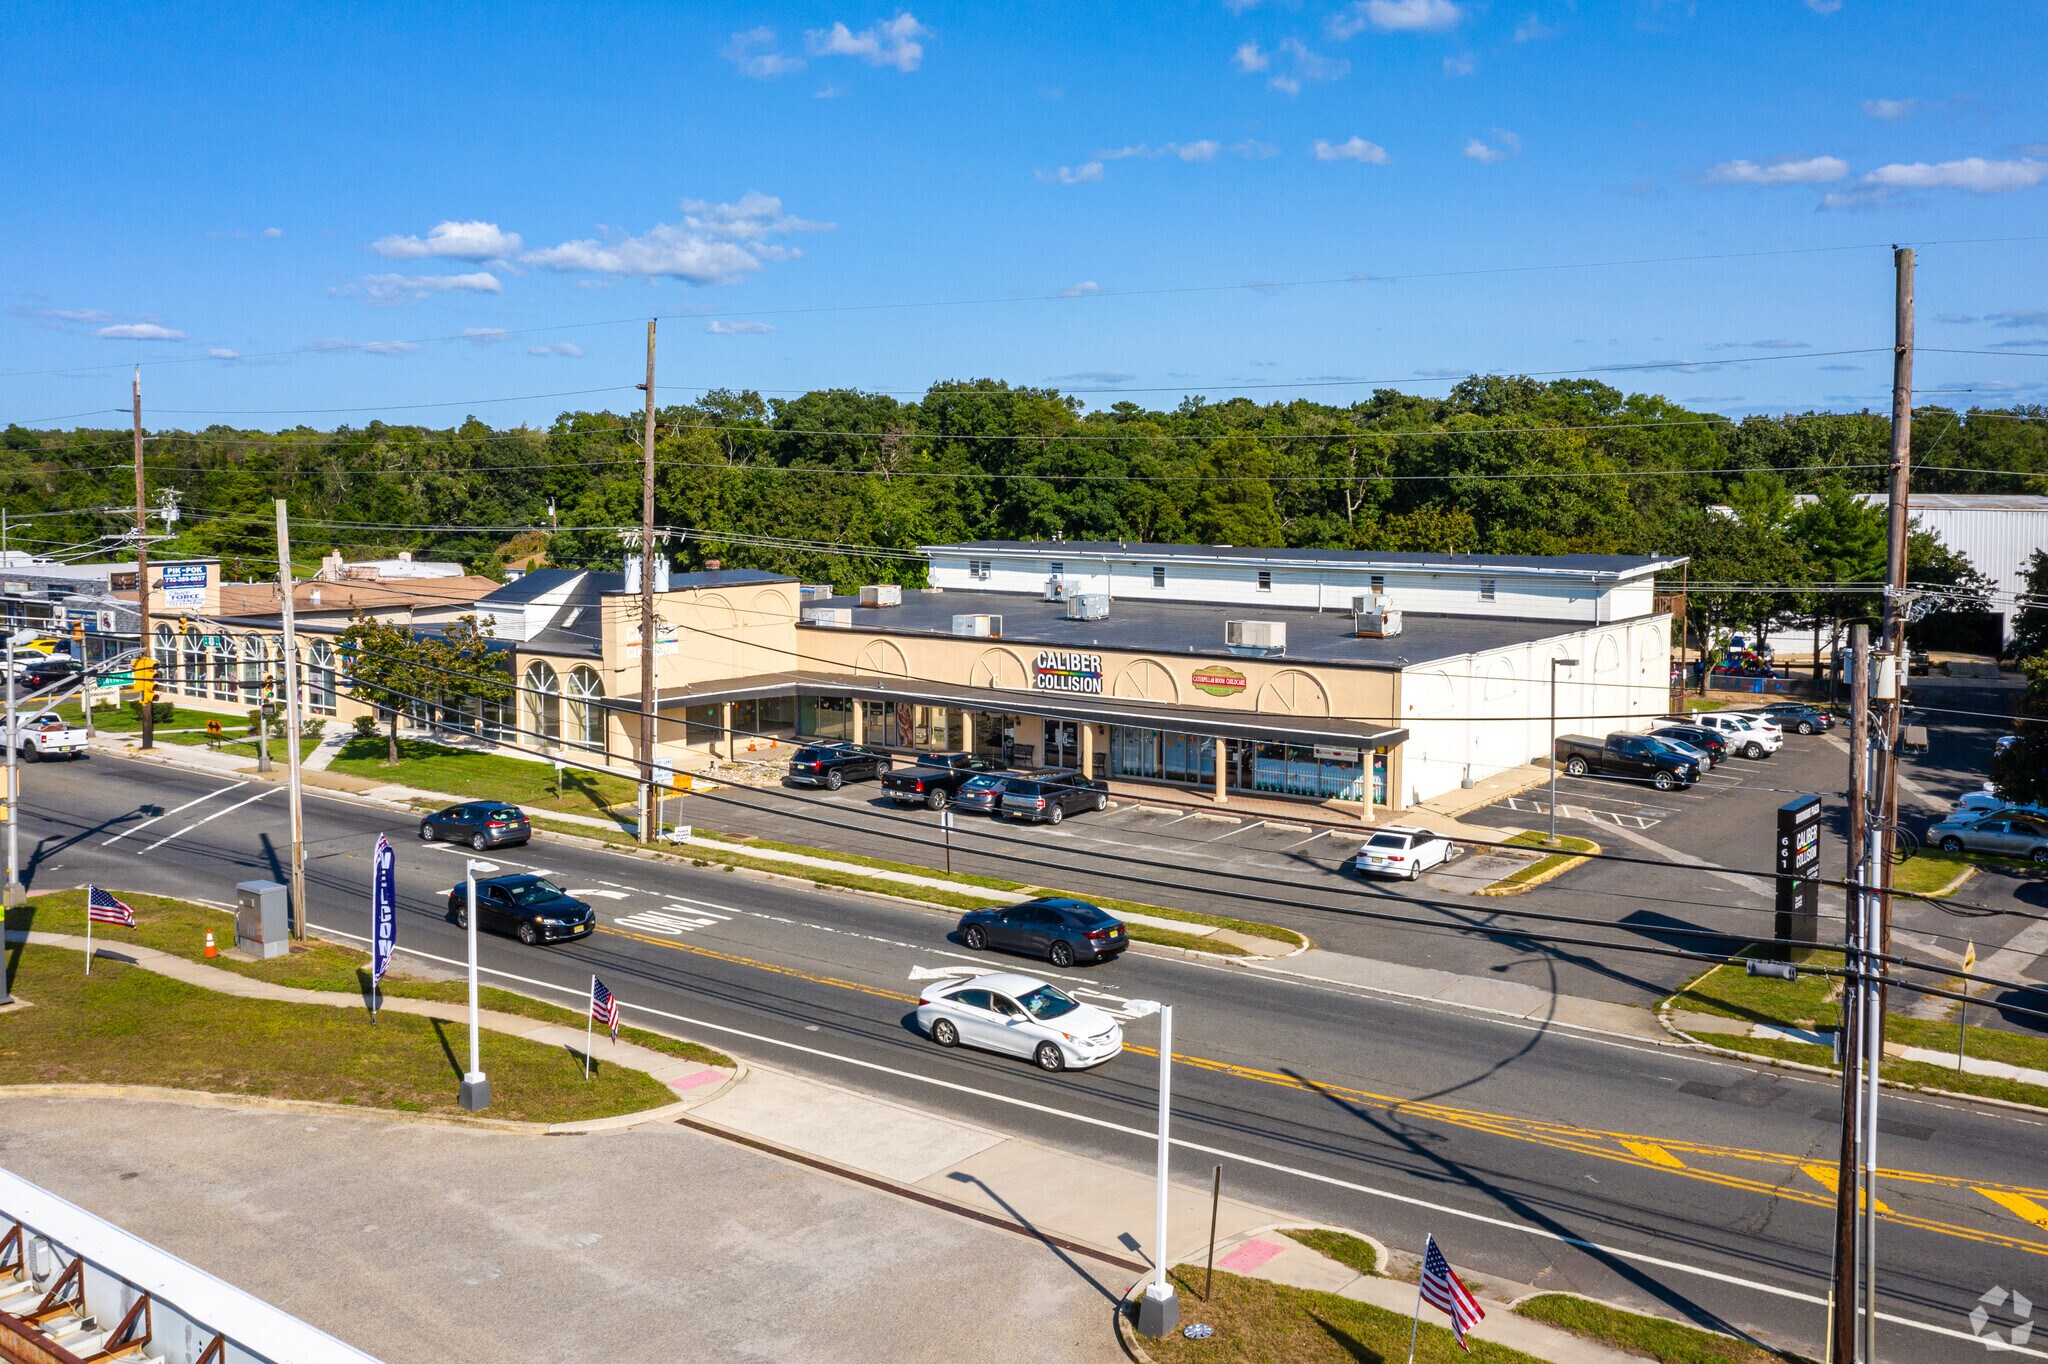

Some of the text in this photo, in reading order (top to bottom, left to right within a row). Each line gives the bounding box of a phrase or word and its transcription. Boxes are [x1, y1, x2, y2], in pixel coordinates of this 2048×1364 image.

[1037, 651, 1101, 672] CALIBER
[1037, 674, 1102, 693] COLLISION
[1796, 824, 1818, 850] CALIBER
[1796, 846, 1817, 868] COLLISION
